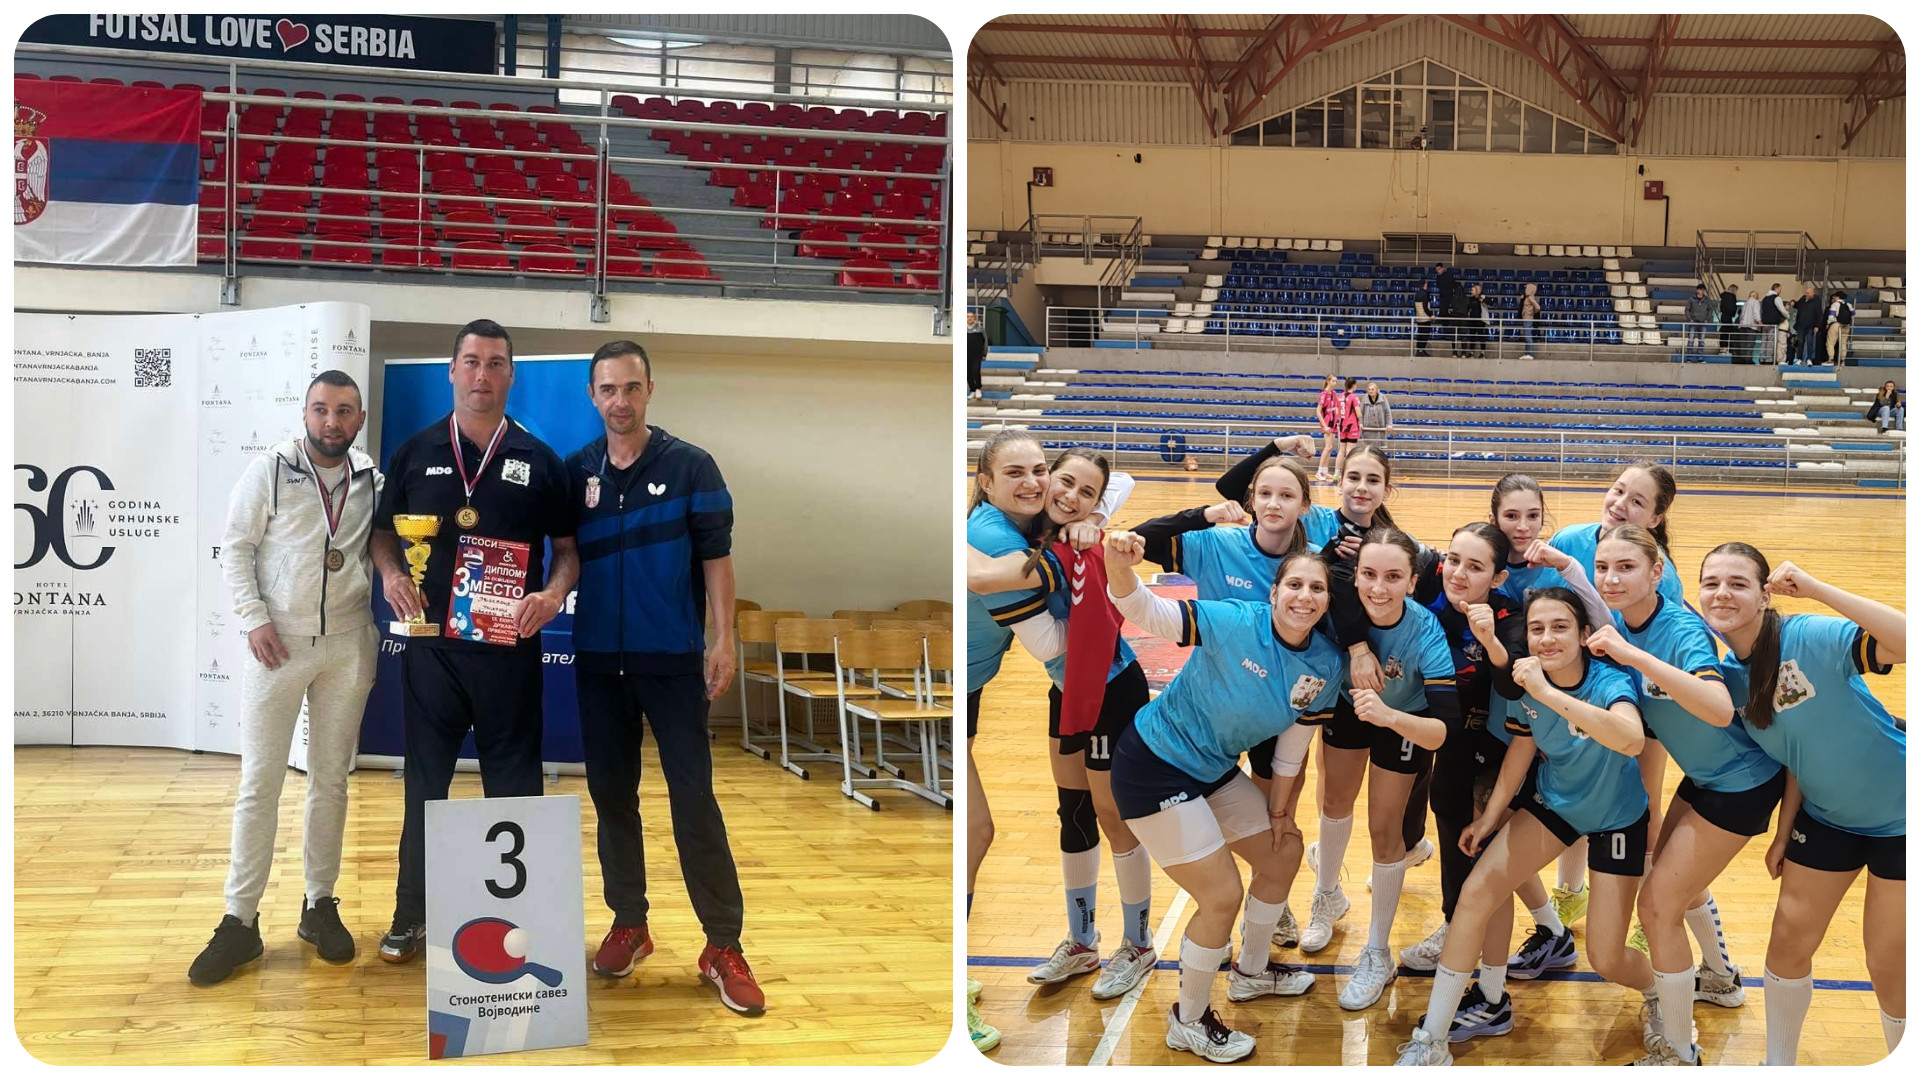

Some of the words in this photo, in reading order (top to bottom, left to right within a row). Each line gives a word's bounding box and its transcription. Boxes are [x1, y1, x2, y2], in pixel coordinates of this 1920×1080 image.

[89, 14, 197, 44] FUTSAL
[204, 16, 272, 49] LOVE
[315, 23, 416, 60] SERBIA
[425, 466, 453, 476] MDG
[108, 500, 161, 509] GODINA
[108, 515, 180, 524] VRHUNSKE
[109, 529, 160, 537] USLUGE
[460, 535, 498, 548] СТСОСИ
[484, 565, 527, 579] ДИПЛОМУ
[453, 567, 471, 597] 3
[470, 579, 525, 598] МЕСТО
[1225, 574, 1253, 590] MDG
[1241, 657, 1268, 678] MDG
[1090, 735, 1110, 759] 11
[1400, 737, 1413, 761] 9
[1159, 791, 1188, 811] MDG
[1611, 832, 1626, 860] 0
[484, 821, 528, 899] 3
[449, 991, 533, 1006] Стонотениски
[535, 988, 568, 1000] савез
[478, 1003, 541, 1020] Војводине
